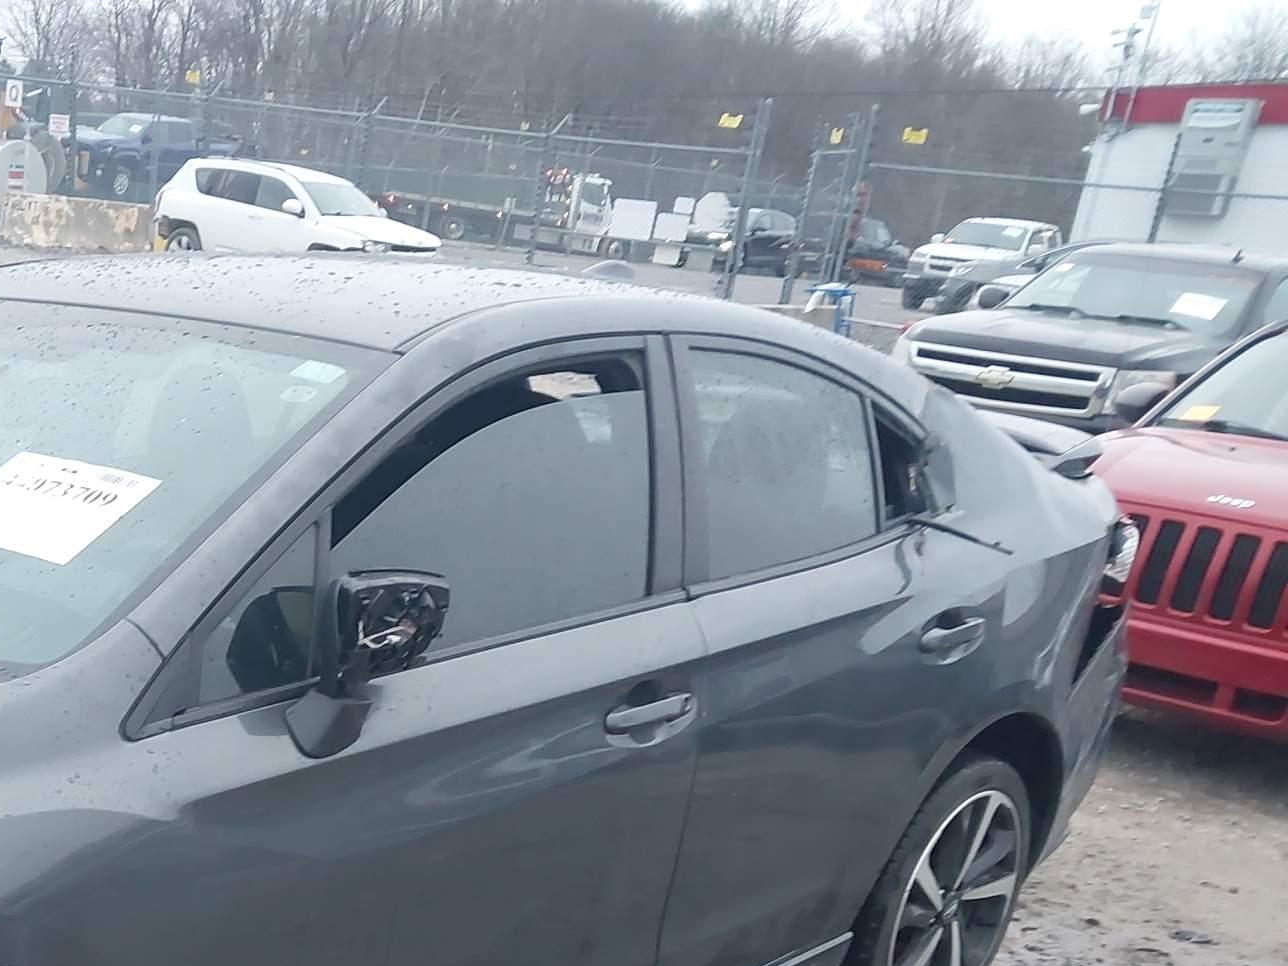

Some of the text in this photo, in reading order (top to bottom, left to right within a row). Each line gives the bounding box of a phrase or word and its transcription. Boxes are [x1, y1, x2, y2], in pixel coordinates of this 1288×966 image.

[8, 84, 20, 102] Q
[1, 472, 119, 507] 073709
[1206, 493, 1257, 509] Jeep
